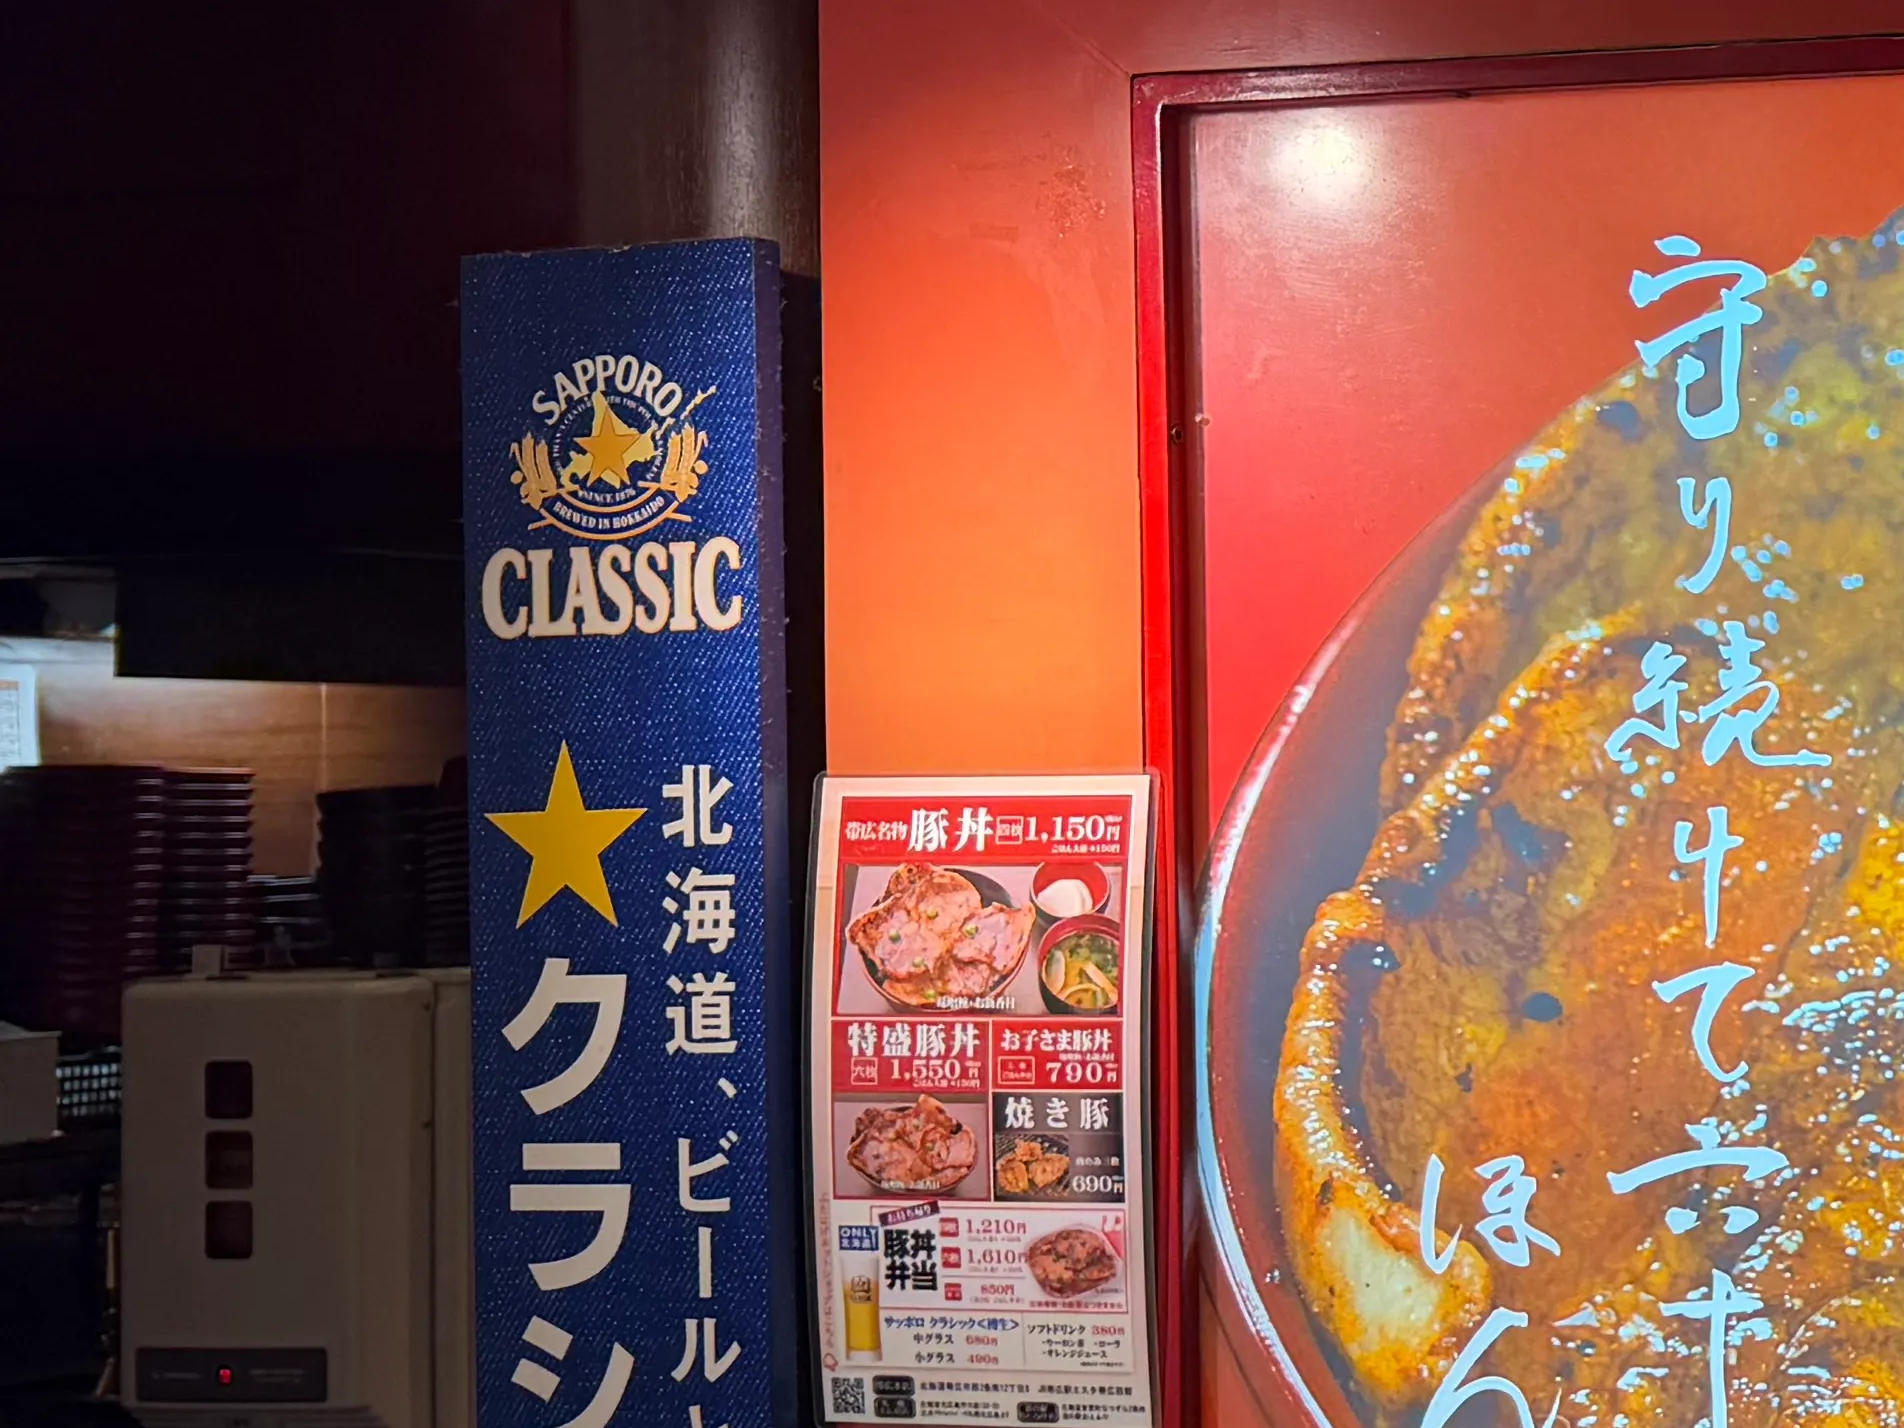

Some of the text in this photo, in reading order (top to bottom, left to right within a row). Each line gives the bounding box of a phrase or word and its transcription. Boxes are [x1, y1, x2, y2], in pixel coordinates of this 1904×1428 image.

[532, 355, 682, 425] SAPPORO
[552, 496, 666, 529] BREWED IN HOKKAIDO
[481, 538, 744, 641] CLASSIC
[846, 821, 907, 840] 帯広名物
[908, 808, 994, 852] 豚丼
[1025, 816, 1122, 841] 1,150円
[848, 1023, 980, 1056] 特盛豚丼
[1001, 1028, 1113, 1051] お子さま豚丼
[890, 1060, 980, 1079] 1,550円
[1046, 1063, 1116, 1083] 790円
[1005, 1096, 1109, 1130] 焼き豚
[1072, 1175, 1123, 1194] 690円
[965, 1219, 1027, 1235] 1,210円
[883, 1229, 936, 1259] 豚丼
[885, 1261, 938, 1291] 弁当
[980, 1284, 1015, 1295] 850円
